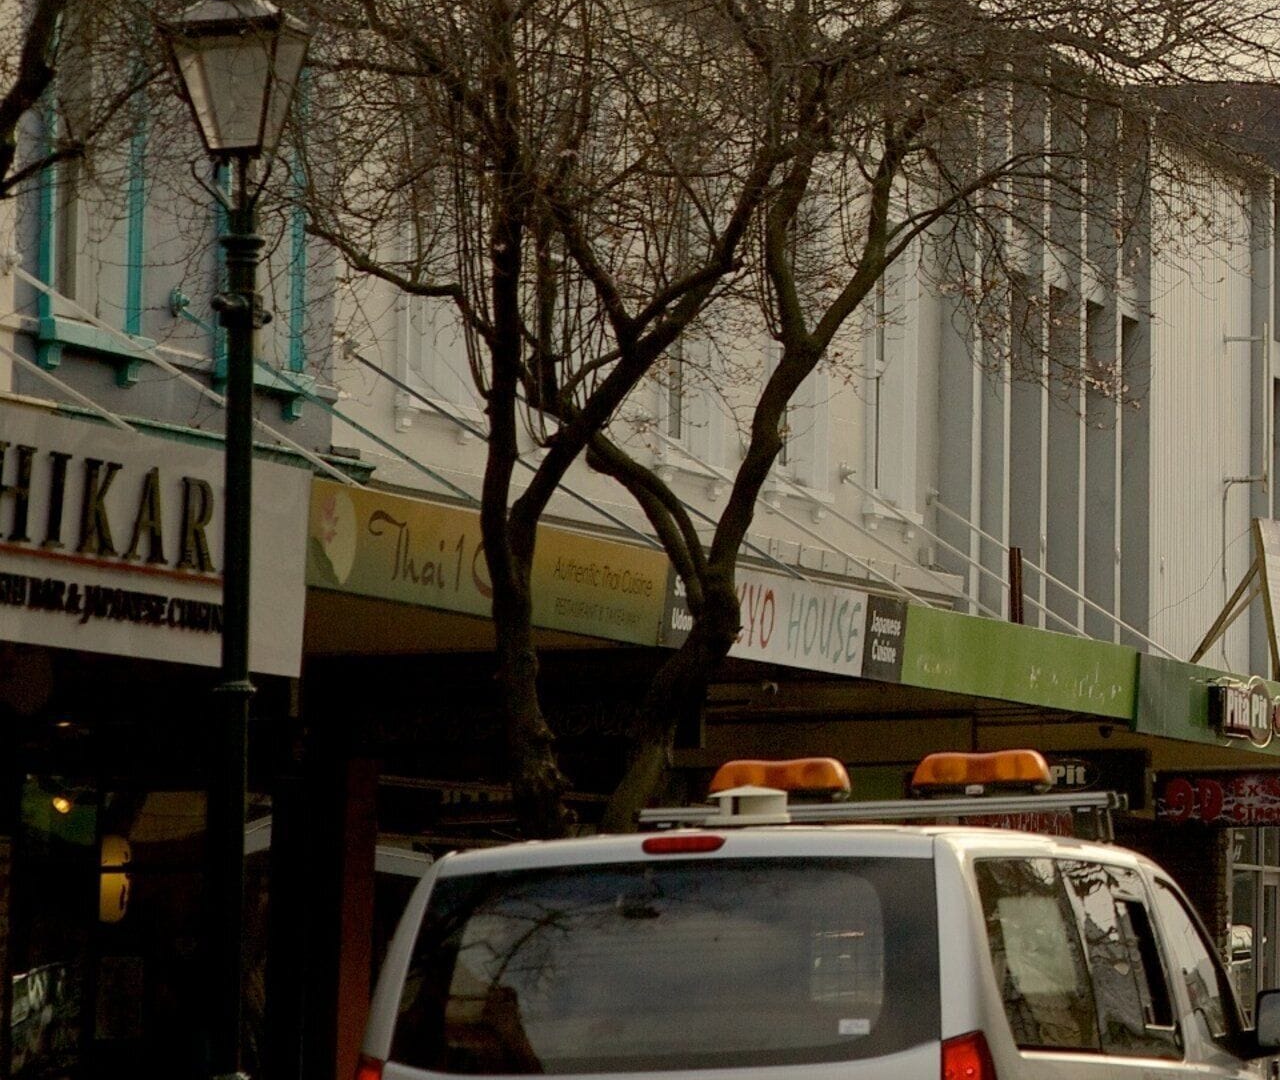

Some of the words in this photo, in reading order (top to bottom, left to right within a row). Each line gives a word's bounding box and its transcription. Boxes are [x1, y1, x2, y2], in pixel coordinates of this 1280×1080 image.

[0, 441, 218, 572] HIKAR
[368, 510, 446, 590] Thai
[786, 591, 863, 664] HOUSE
[871, 608, 901, 637] Japanese
[871, 638, 898, 665] Cuisine
[1226, 688, 1250, 729] Pita
[1251, 691, 1270, 730] Pit
[1051, 764, 1087, 785] Pit
